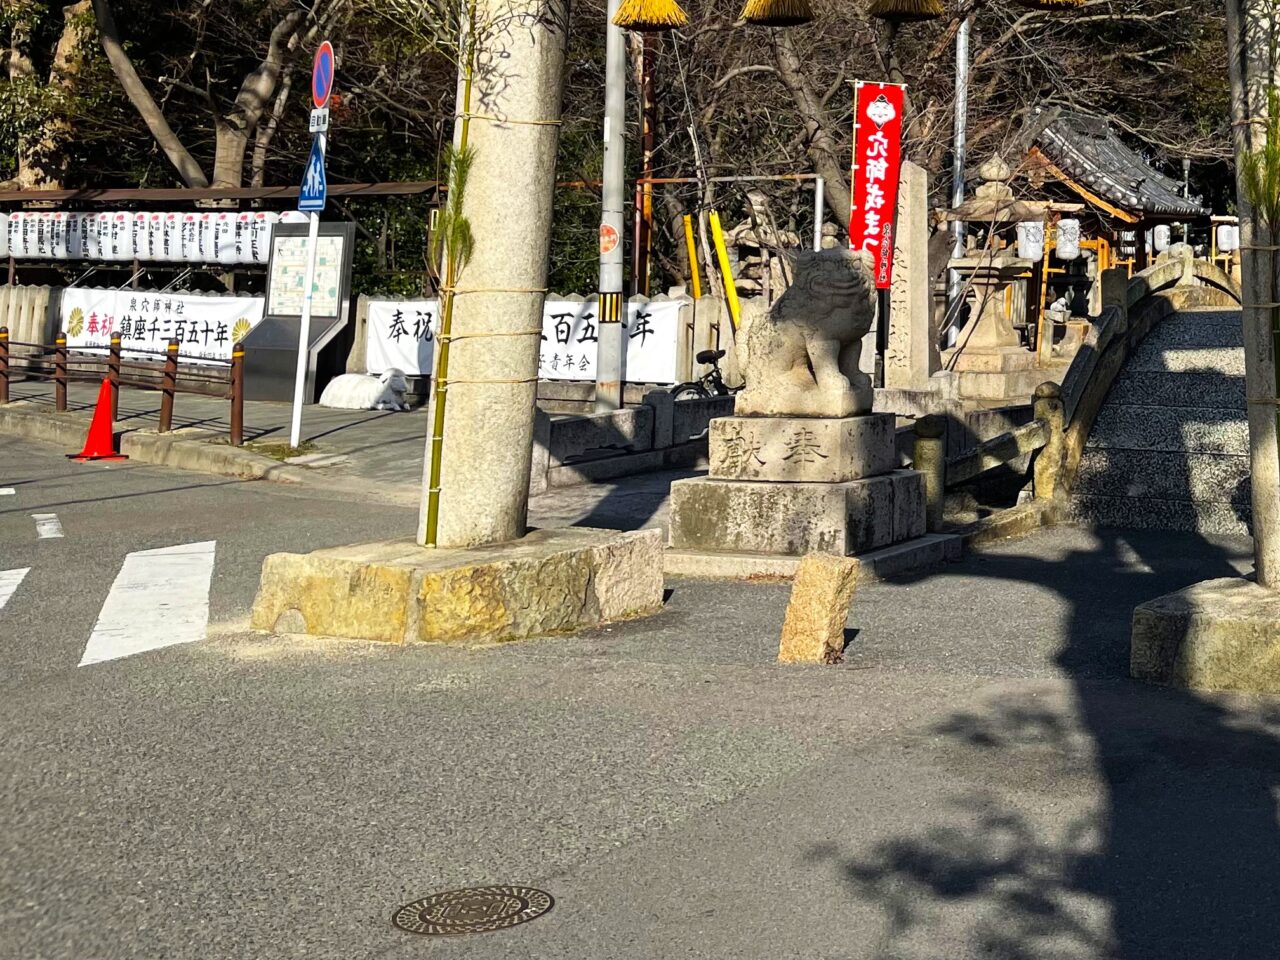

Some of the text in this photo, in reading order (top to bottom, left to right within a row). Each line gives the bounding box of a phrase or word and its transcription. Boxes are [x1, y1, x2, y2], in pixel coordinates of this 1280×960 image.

[129, 296, 185, 314] 泉穴師神社
[87, 311, 229, 348] 奉祝 鎮座千三百五十年
[388, 309, 433, 342] 奉祝
